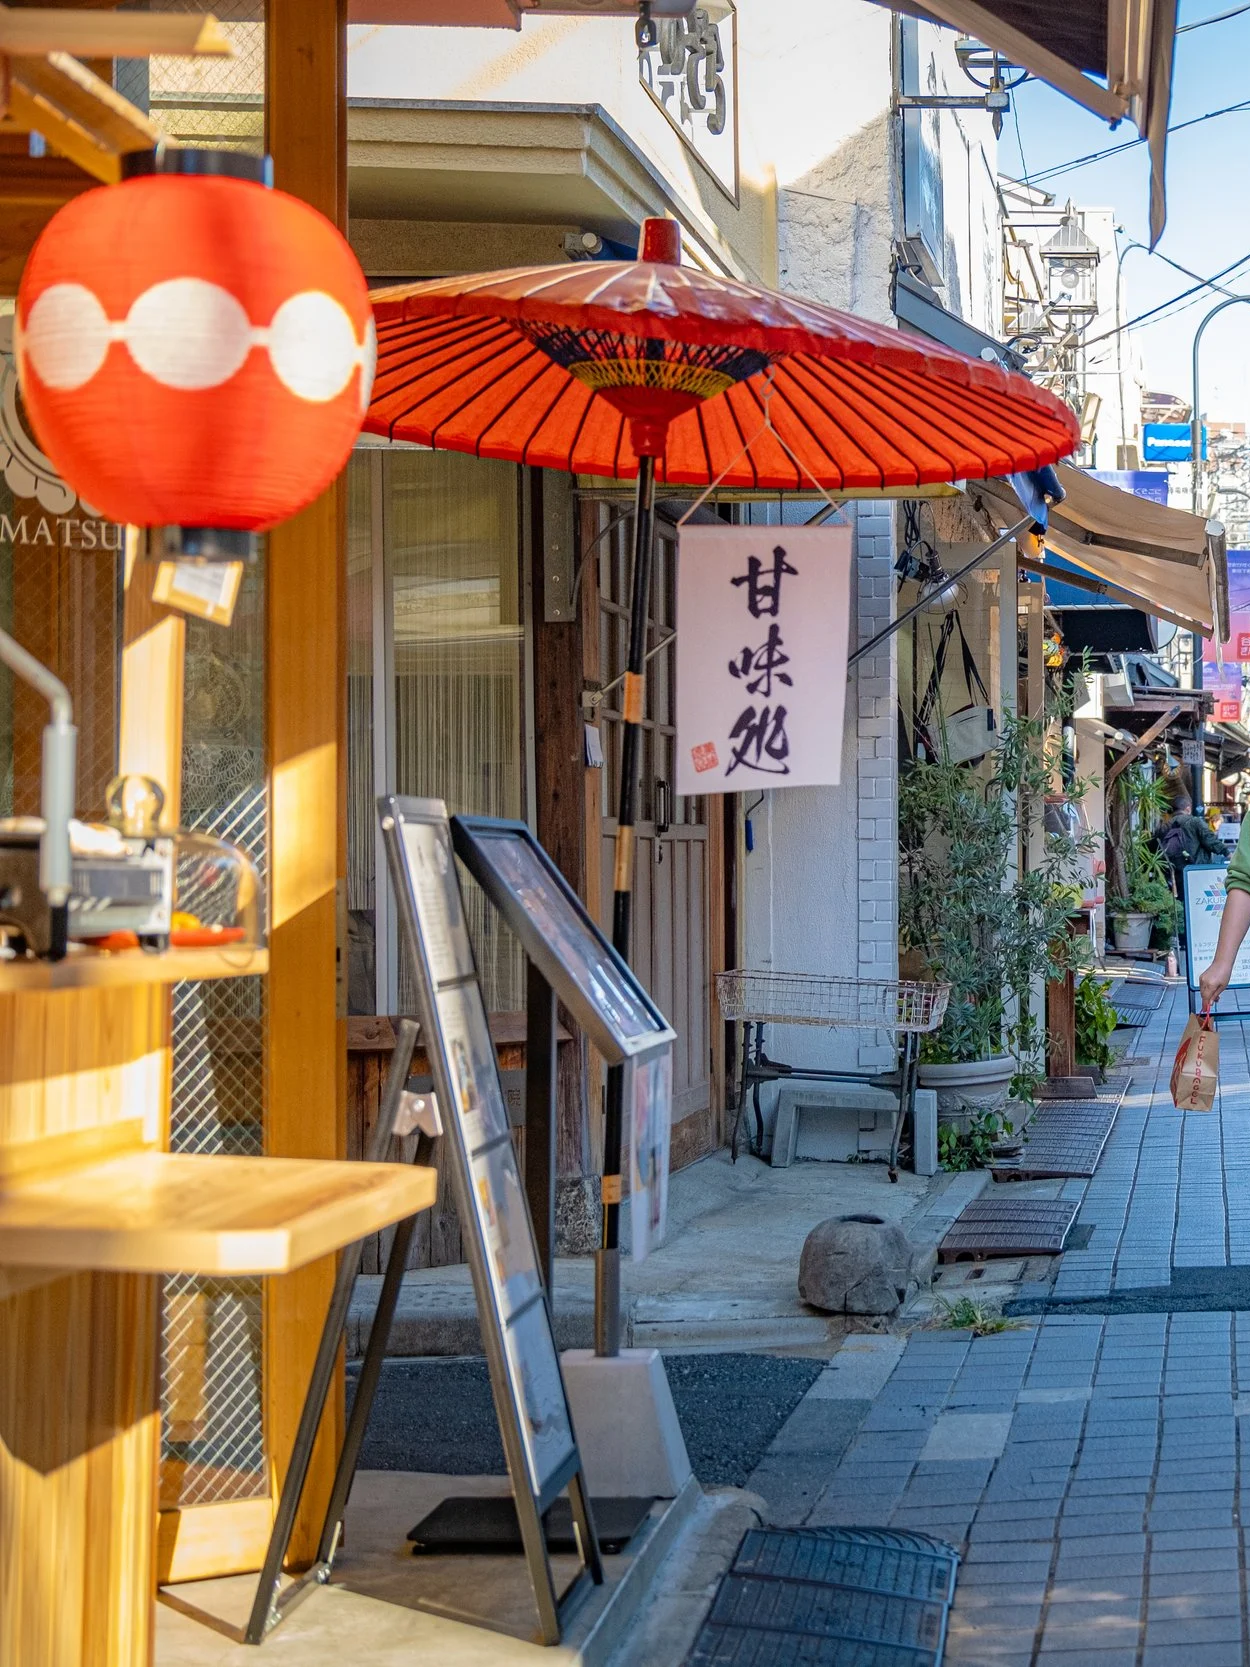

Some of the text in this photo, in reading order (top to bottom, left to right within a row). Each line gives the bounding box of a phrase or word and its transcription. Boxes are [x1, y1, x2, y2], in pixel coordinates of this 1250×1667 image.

[724, 545, 799, 777] 甘味処
[1196, 897, 1226, 905] ZAKUR
